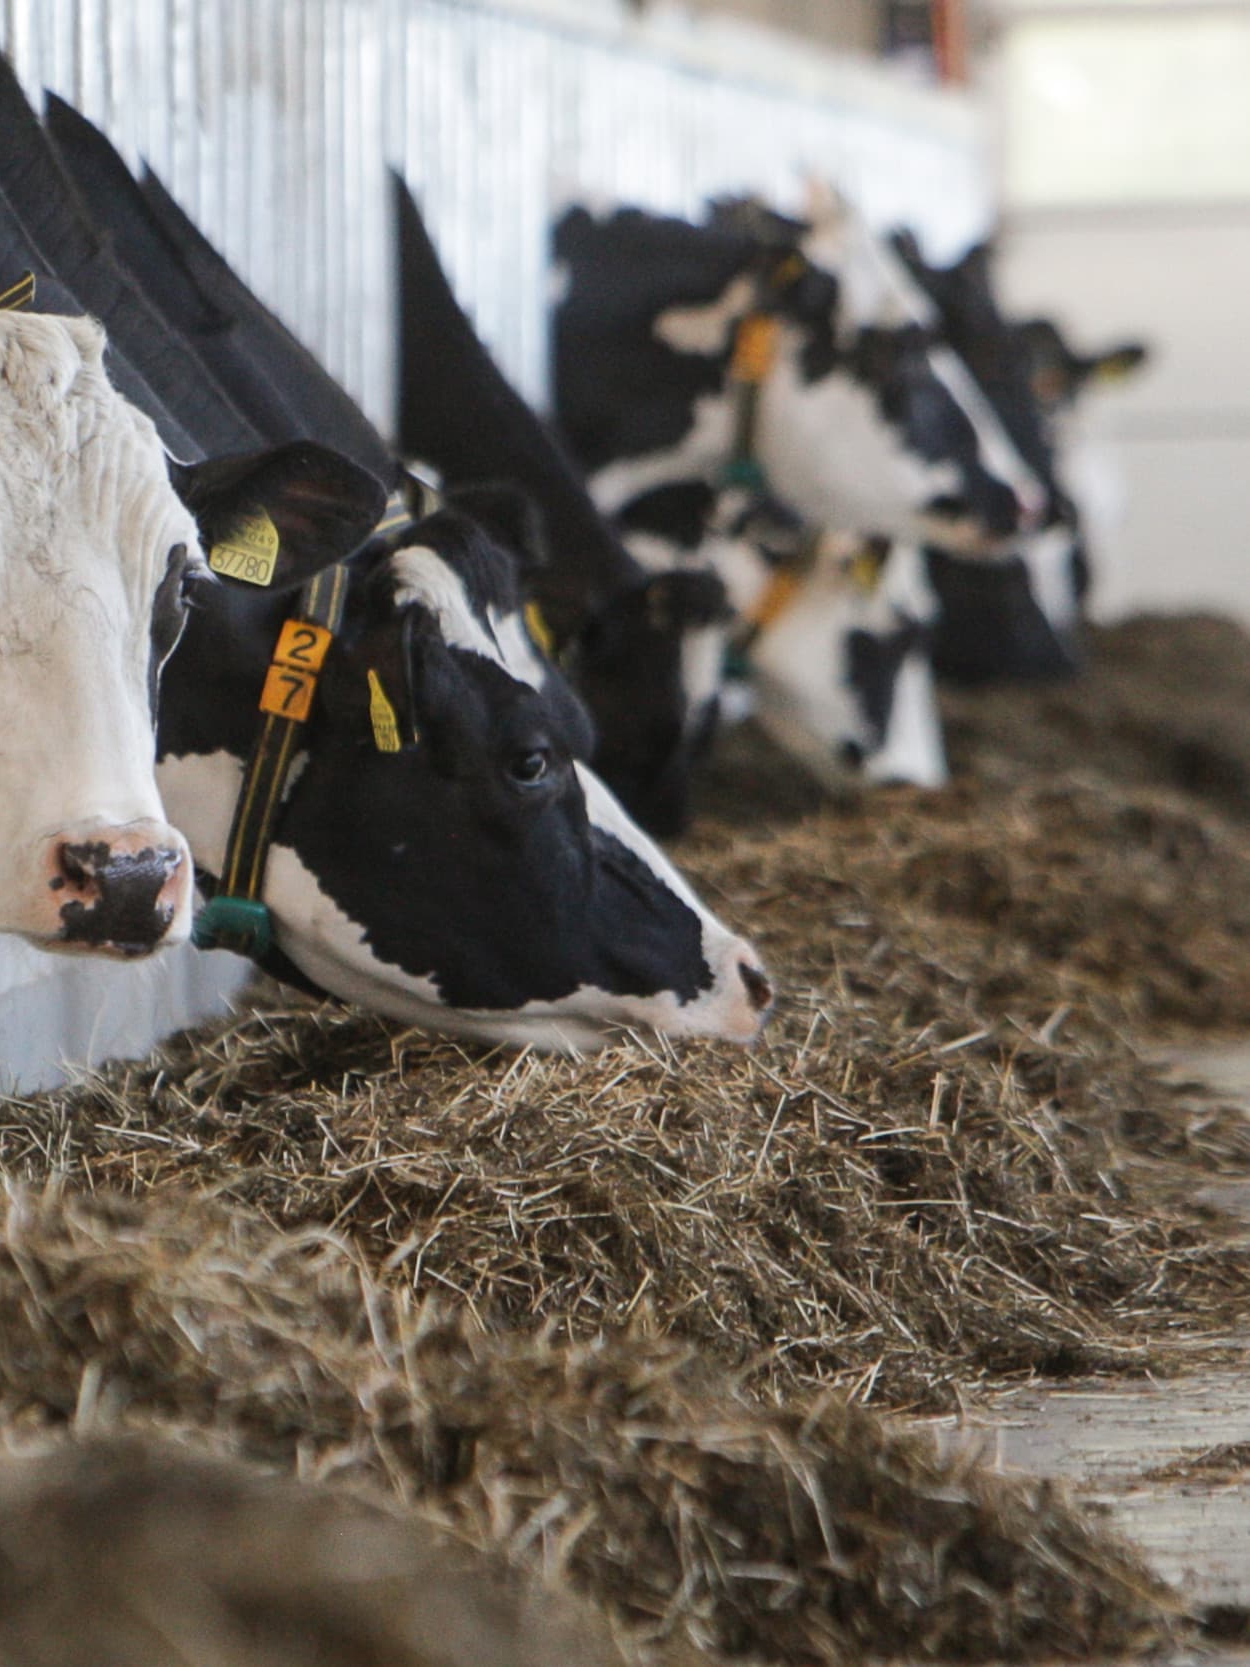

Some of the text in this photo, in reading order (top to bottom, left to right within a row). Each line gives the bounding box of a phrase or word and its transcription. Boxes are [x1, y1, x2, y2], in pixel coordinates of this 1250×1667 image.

[212, 547, 270, 582] 37780
[288, 629, 317, 663] 2
[280, 675, 305, 711] 7
